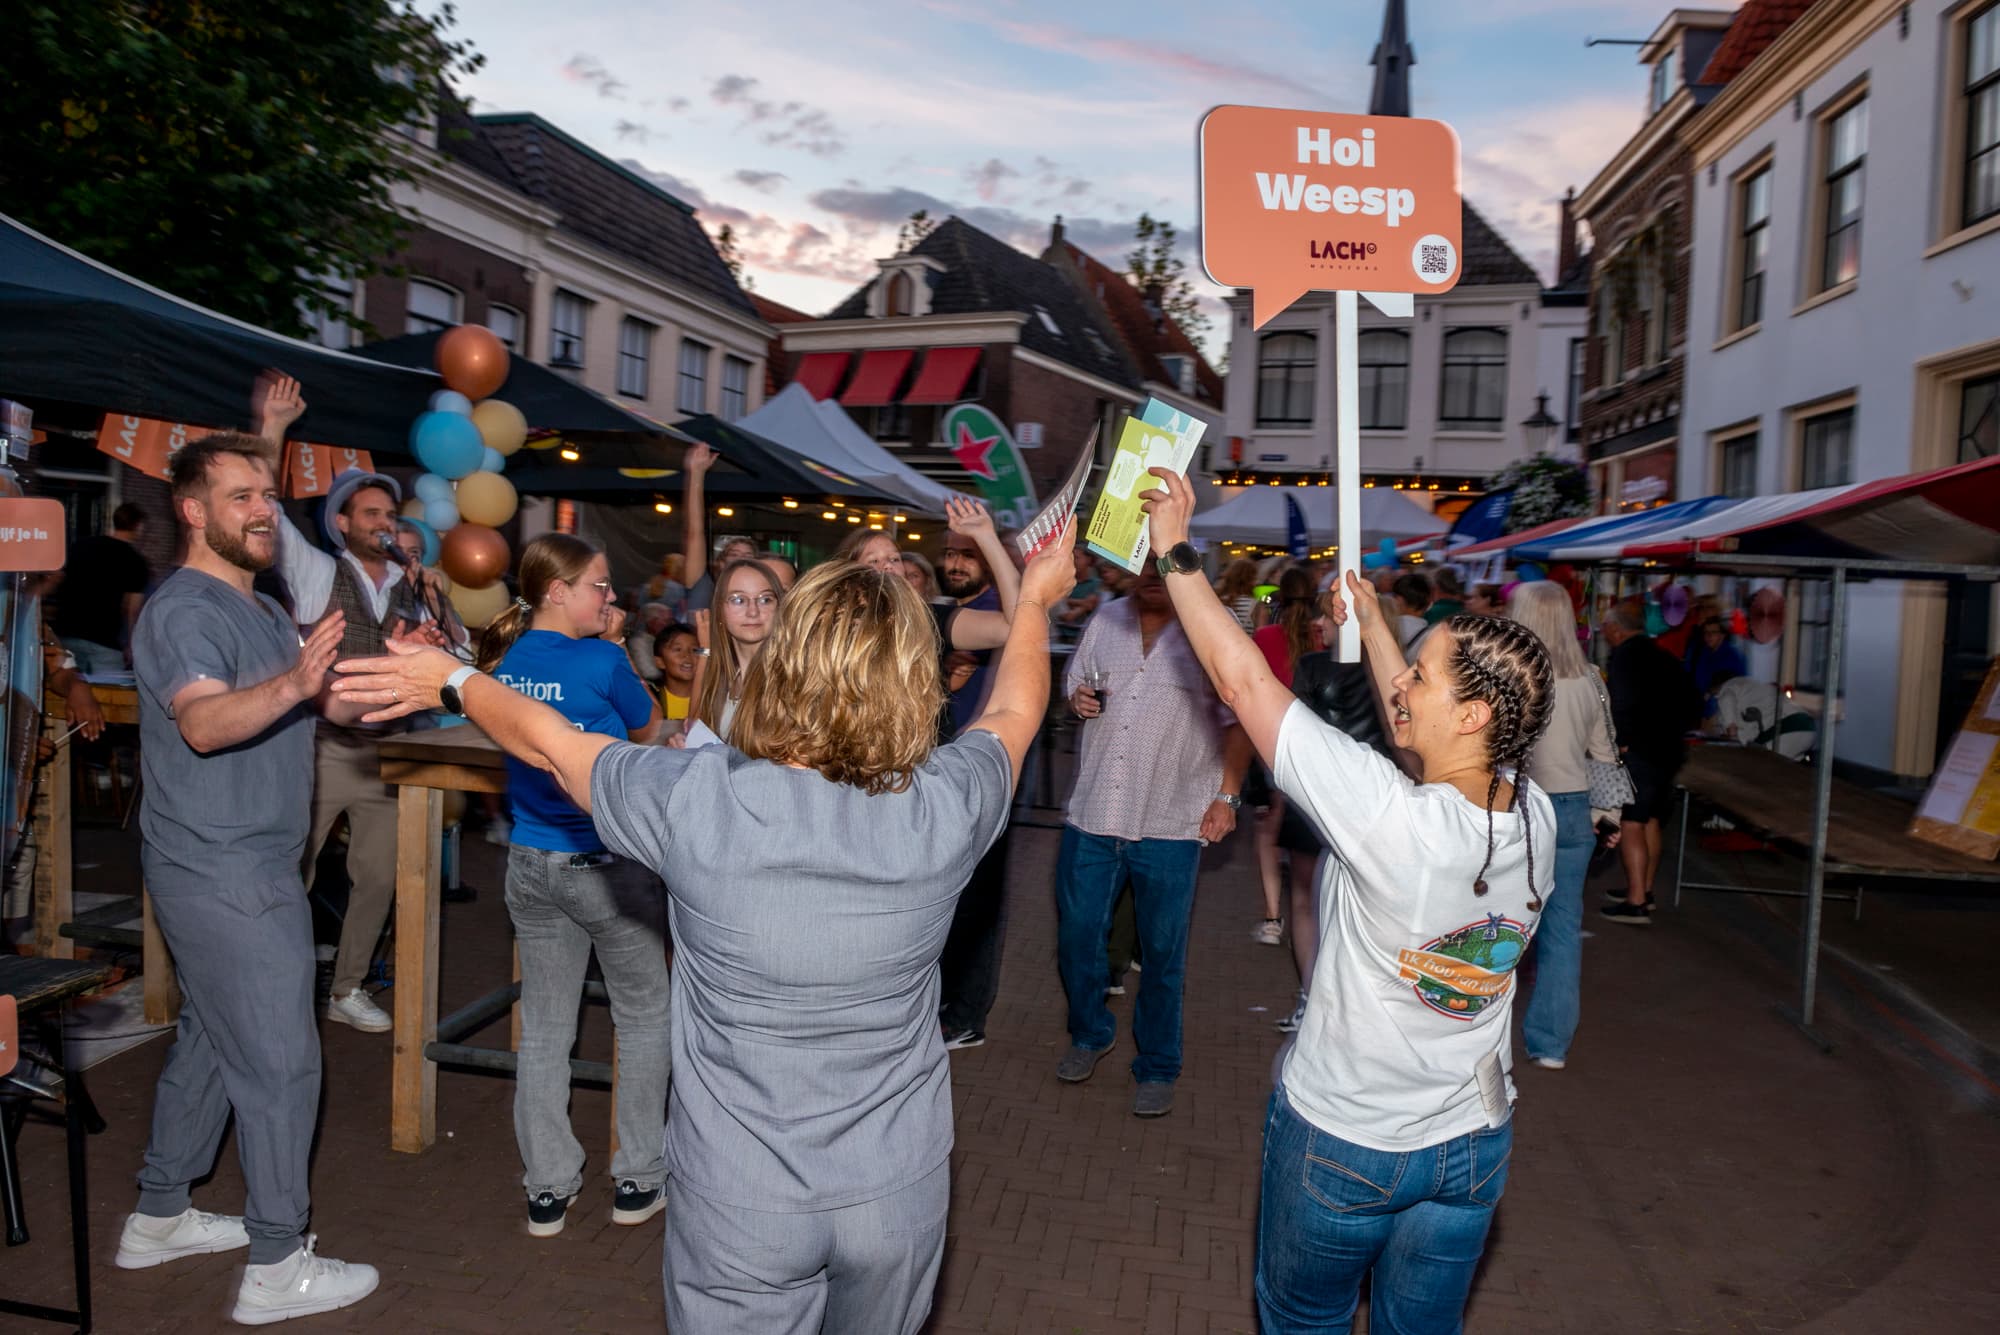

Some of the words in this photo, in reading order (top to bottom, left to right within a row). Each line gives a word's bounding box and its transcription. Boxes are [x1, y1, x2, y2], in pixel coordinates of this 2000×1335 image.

[1297, 127, 1376, 168] Hoi
[1255, 172, 1416, 227] Weesp
[1423, 958, 1456, 978] hou
